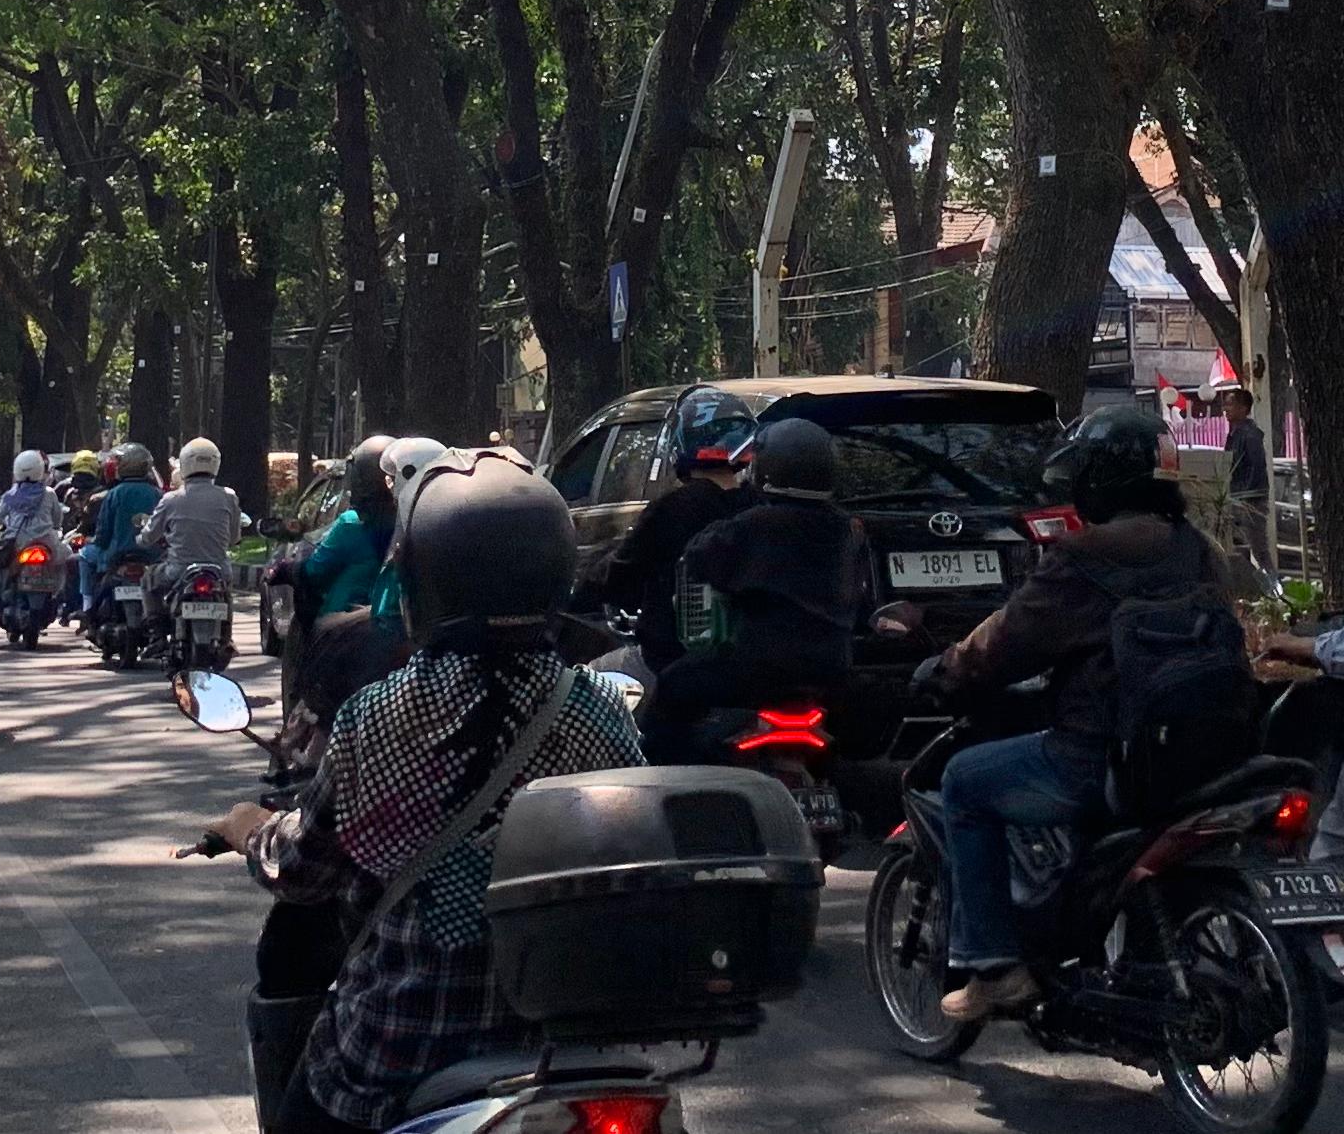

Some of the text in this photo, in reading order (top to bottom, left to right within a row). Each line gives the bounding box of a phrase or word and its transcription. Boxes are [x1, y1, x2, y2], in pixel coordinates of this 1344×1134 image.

[892, 552, 996, 575] N 1891 EL
[1274, 875, 1320, 896] 2132
